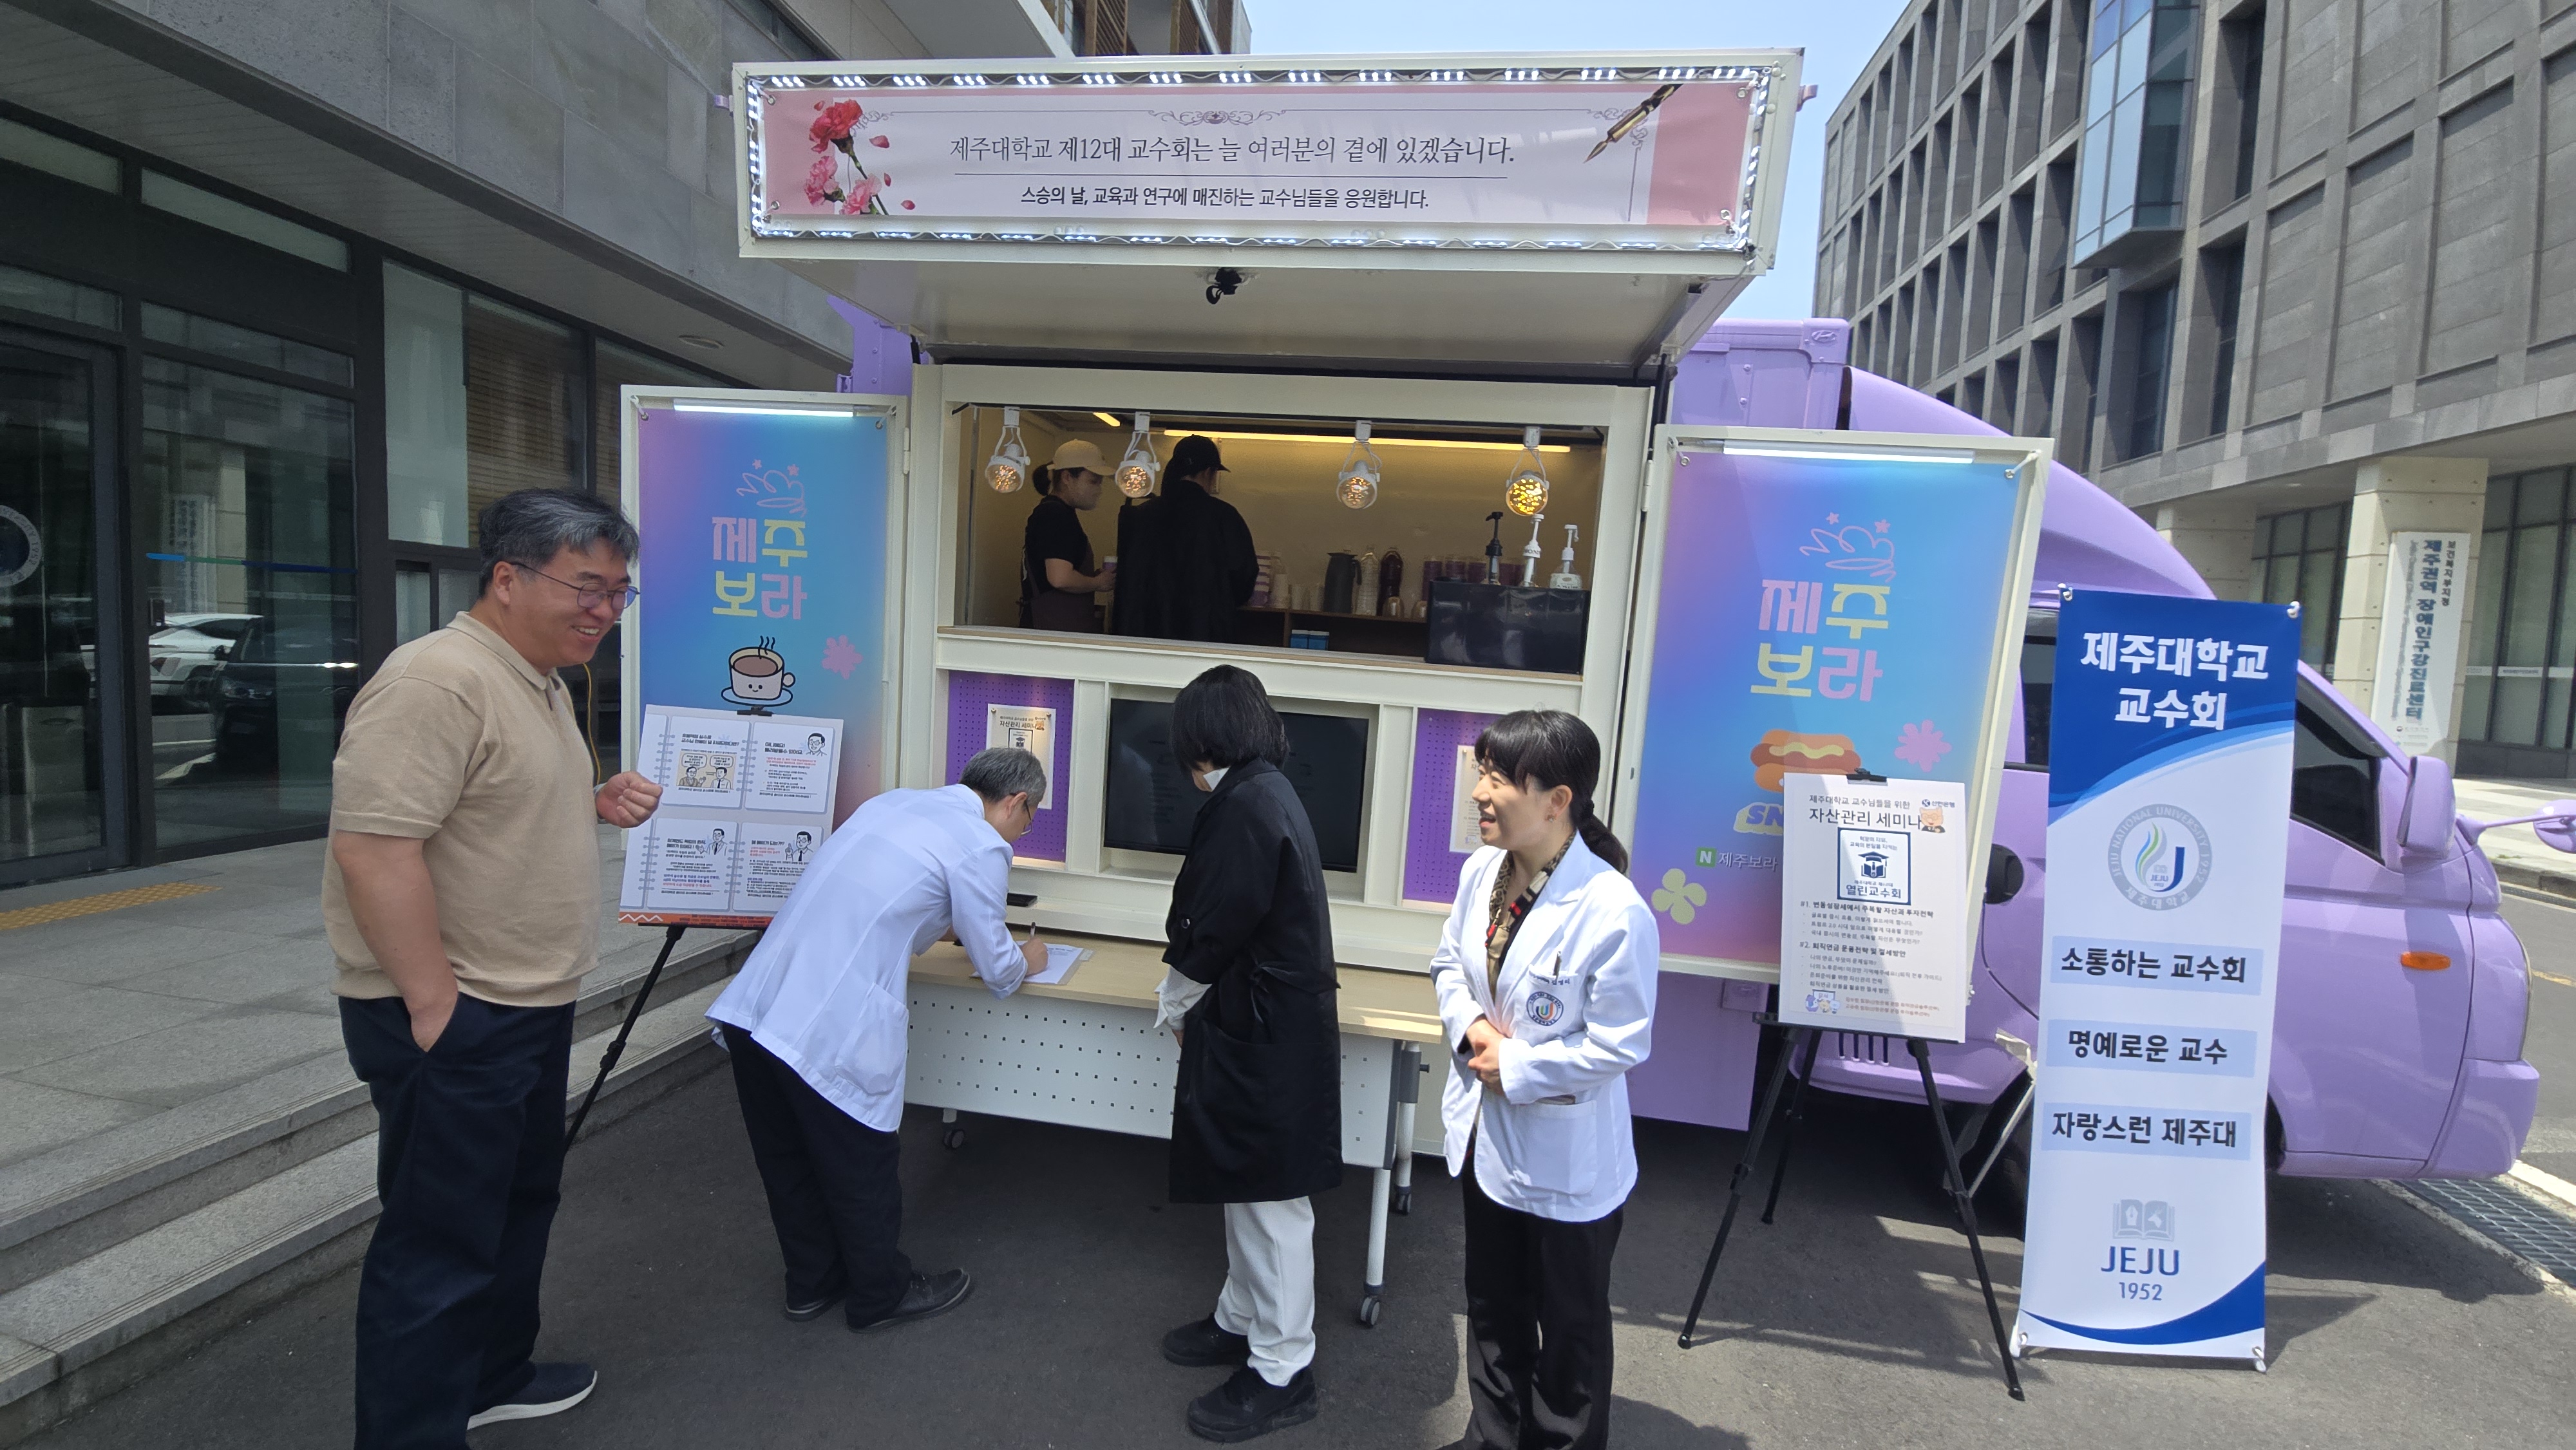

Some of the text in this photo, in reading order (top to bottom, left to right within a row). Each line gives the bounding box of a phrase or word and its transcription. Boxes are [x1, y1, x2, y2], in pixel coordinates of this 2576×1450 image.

[951, 136, 1515, 164] 제주대학교 제12대 교수회는 늘 여러분의 곁에 있겠습니다.
[1021, 186, 1429, 209] 스승의 날, 교육과 연구에 매진하는 교수님들을 응원합니다.
[712, 516, 808, 567] 제주
[2420, 540, 2442, 594] 제주권역
[712, 570, 808, 620] 보라
[1758, 579, 1891, 640] 제주
[1750, 643, 1884, 702] 보라
[2081, 632, 2269, 682] 제주대학교
[2114, 687, 2228, 731] 교수회
[1809, 795, 1910, 809] 제주대학교 교수님들을 위한
[1809, 807, 1921, 829] 자산관리 세미나
[1700, 851, 1779, 872] N 제주보라
[2110, 806, 2210, 883] JEJU NATIONAL UNIVERSITY 1952
[1846, 885, 1901, 899] 열린교수회
[1813, 943, 1839, 951] 퇴직연금
[2061, 947, 2247, 983] 소통하는 교수회
[2069, 1030, 2228, 1065] 명예로운 교수
[2052, 1111, 2237, 1147] 자랑스런 제주대
[2101, 1245, 2180, 1276] JEJU
[2118, 1281, 2163, 1301] 1952
